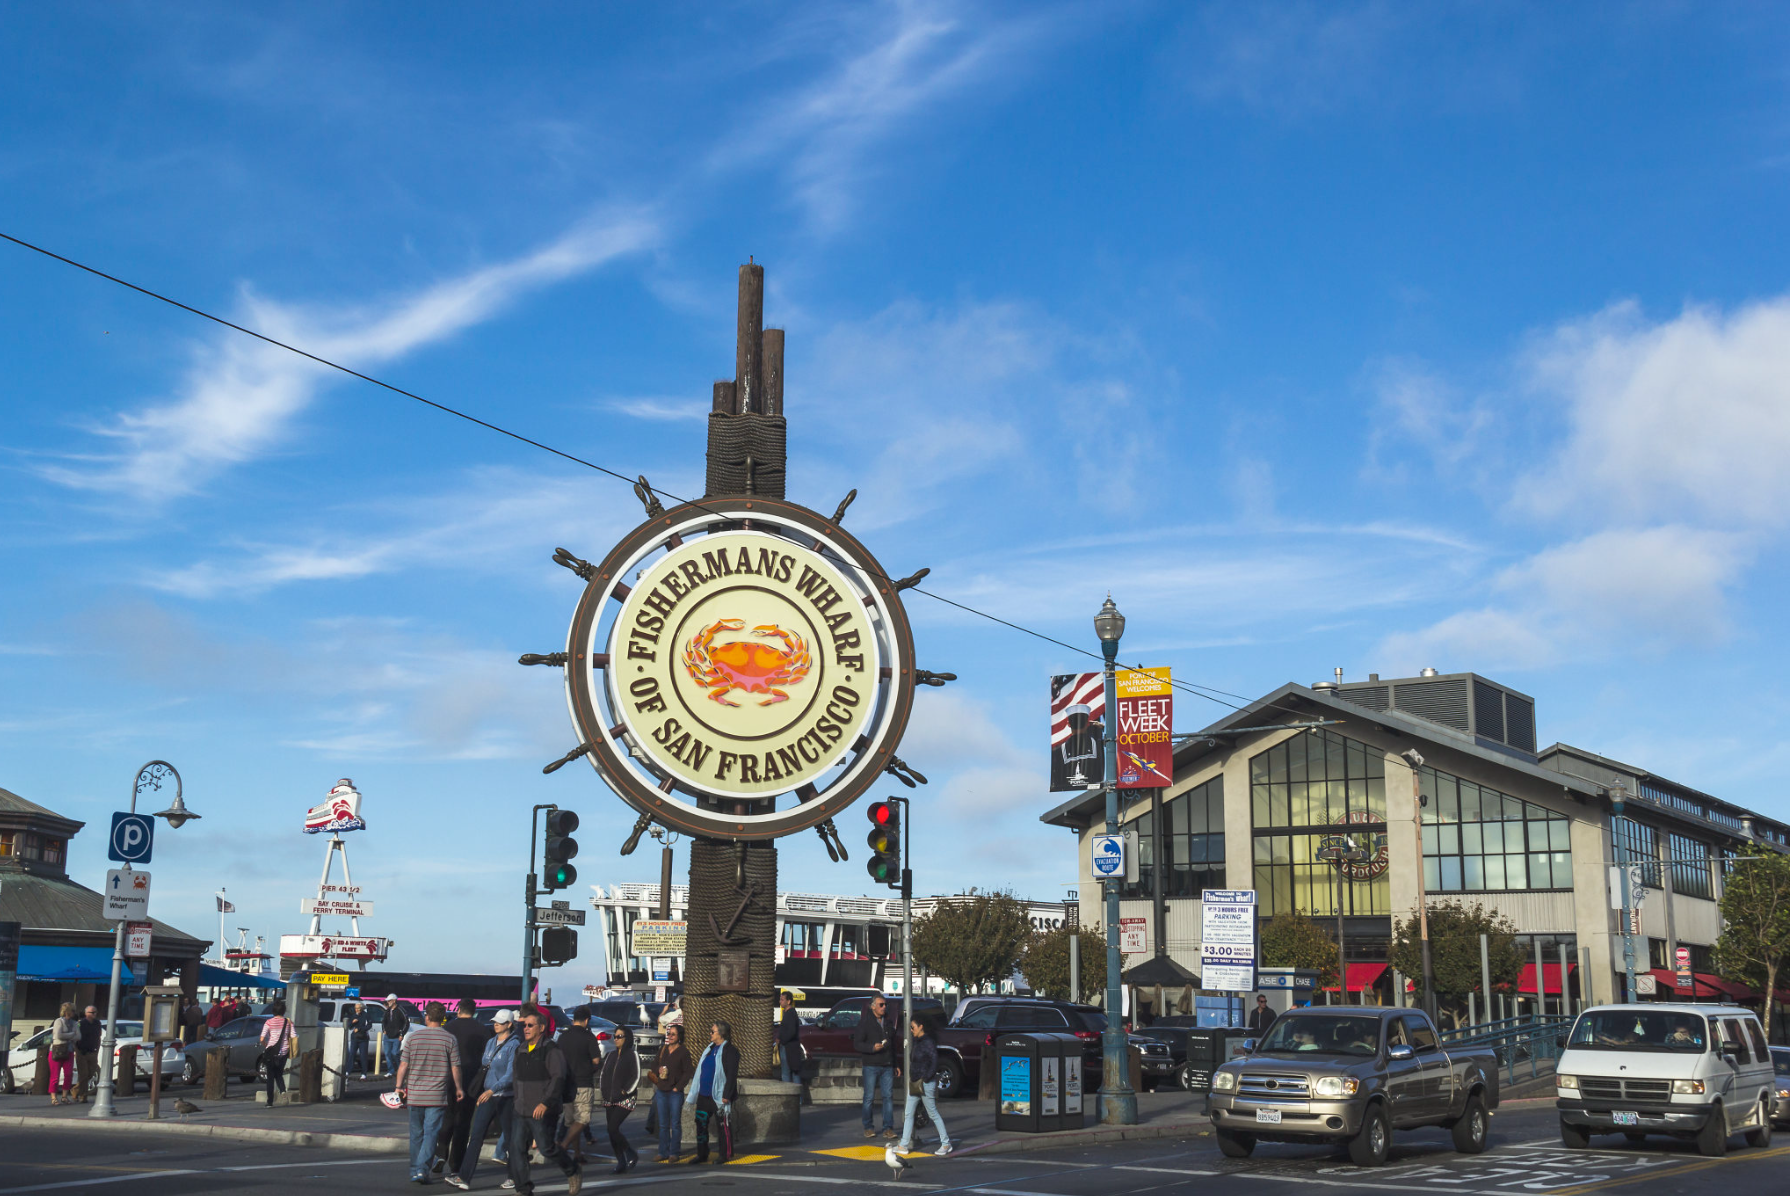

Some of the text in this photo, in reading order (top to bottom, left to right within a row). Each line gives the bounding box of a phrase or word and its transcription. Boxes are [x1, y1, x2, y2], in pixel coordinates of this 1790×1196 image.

[627, 546, 865, 673] FISHERMANS WHARF
[1132, 677, 1169, 686] FRANCISCO
[1126, 685, 1162, 693] WELCOMES
[1119, 699, 1170, 718] FLEET
[1120, 715, 1170, 733] WEEK
[629, 677, 861, 784] OF SAN FRANCISCO
[1119, 731, 1169, 745] OCTOBER
[110, 895, 145, 903] Fisherman's
[1205, 892, 1251, 902] Fisherman's Wharf
[540, 912, 581, 922] Jefferson
[1204, 946, 1232, 955] $3.00
[1258, 977, 1277, 985] ASE
[1295, 977, 1311, 986] CHASE
